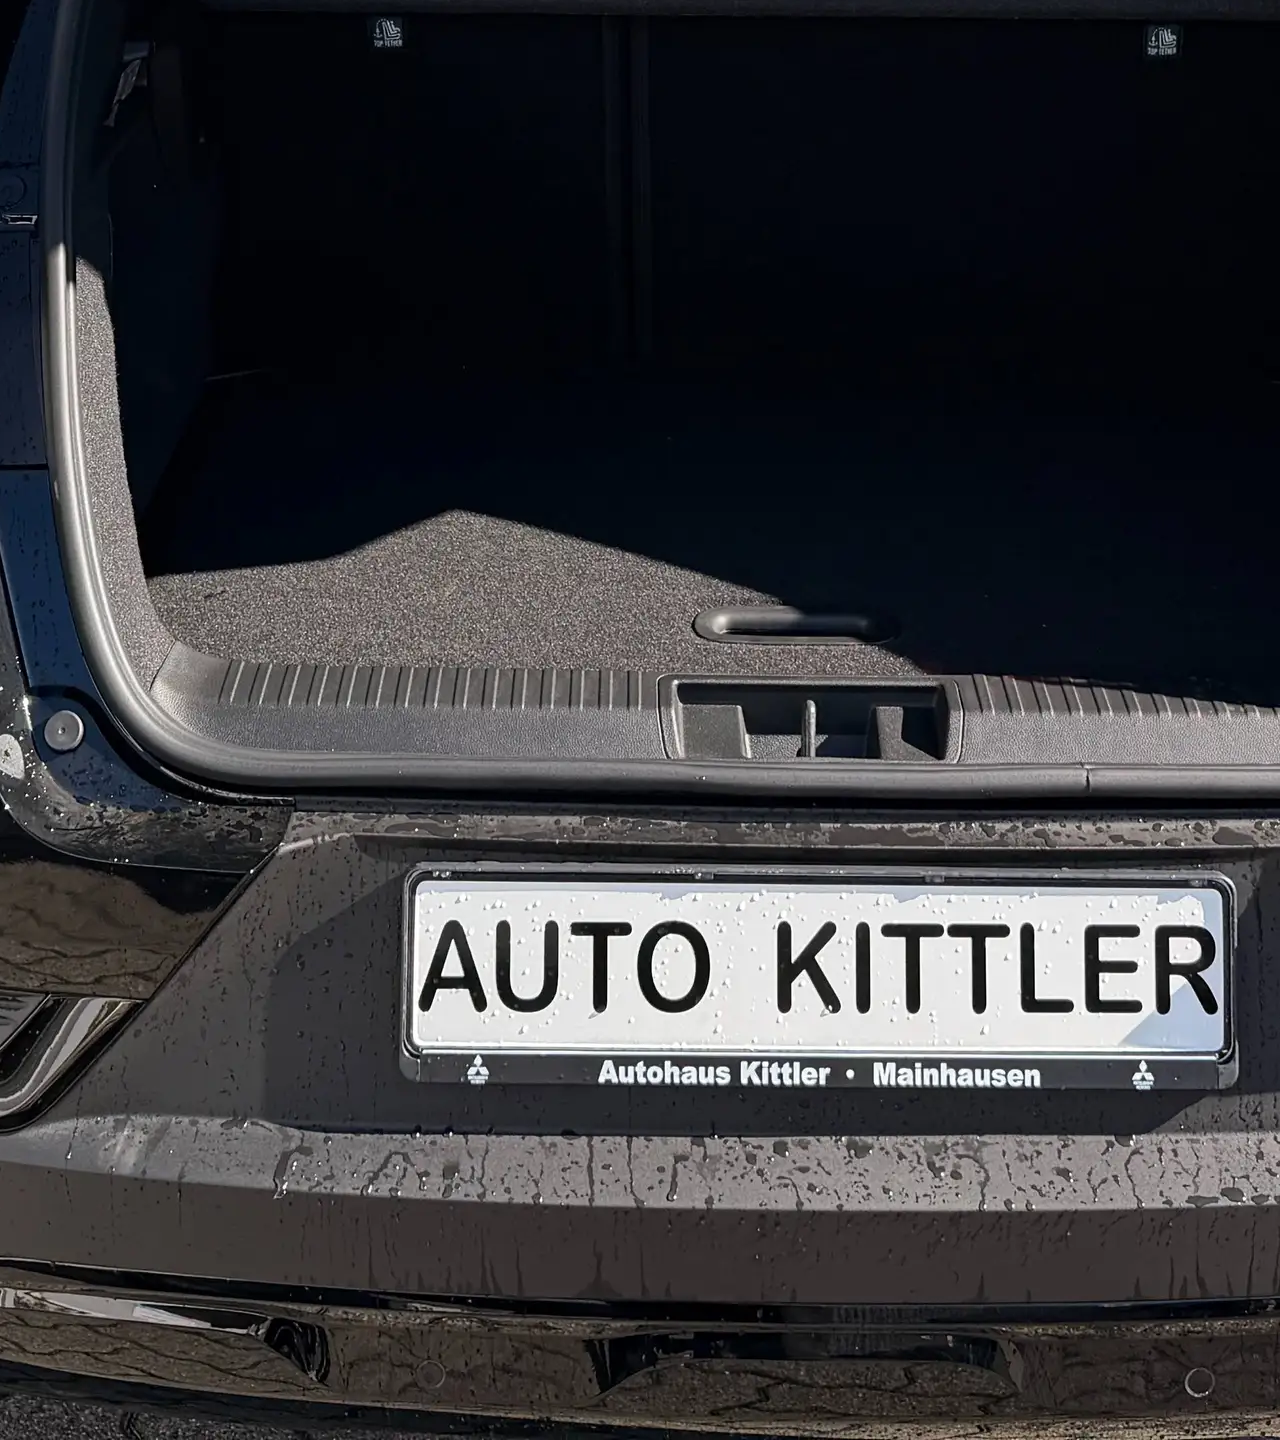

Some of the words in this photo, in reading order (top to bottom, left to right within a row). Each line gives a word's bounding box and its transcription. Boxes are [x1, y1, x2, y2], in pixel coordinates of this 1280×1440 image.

[417, 918, 711, 1014] AUTO
[775, 920, 1219, 1016] KITTLER
[597, 1059, 732, 1086] Autohaus
[739, 1060, 832, 1087] Kittler
[872, 1062, 1041, 1089] Mainhausen
